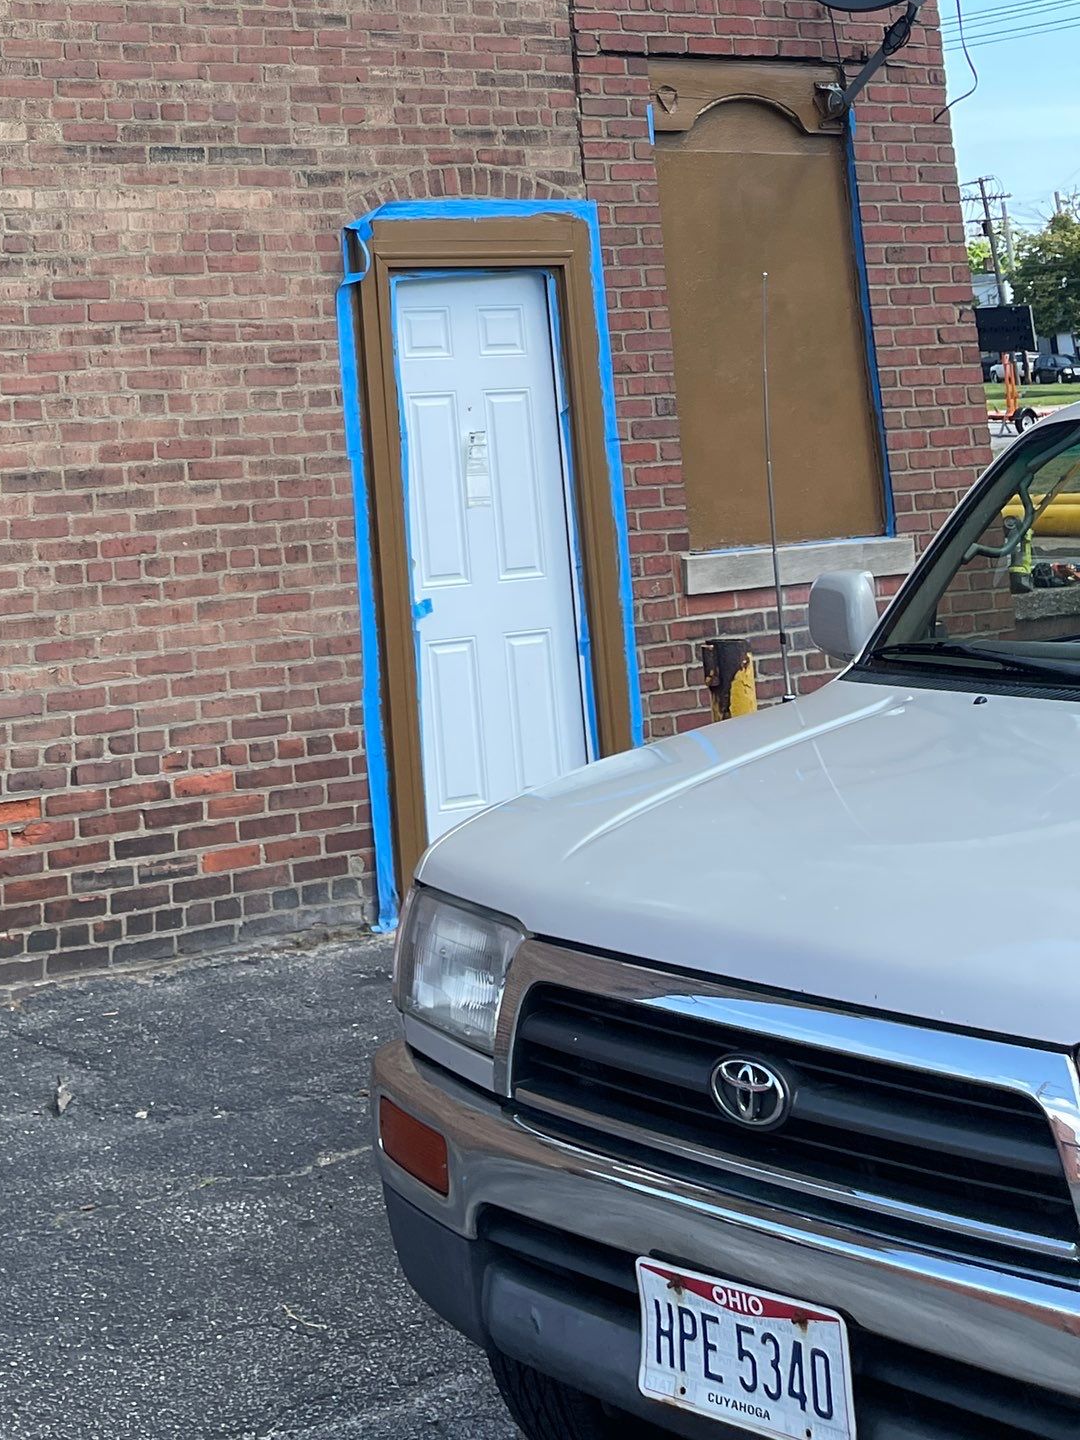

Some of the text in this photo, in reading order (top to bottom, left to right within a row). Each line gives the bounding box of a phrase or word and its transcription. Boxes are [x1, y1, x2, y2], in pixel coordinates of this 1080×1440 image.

[711, 1285, 763, 1316] OHIO
[654, 1298, 834, 1421] HPE 5340
[707, 1392, 771, 1421] CUYAHOGA
